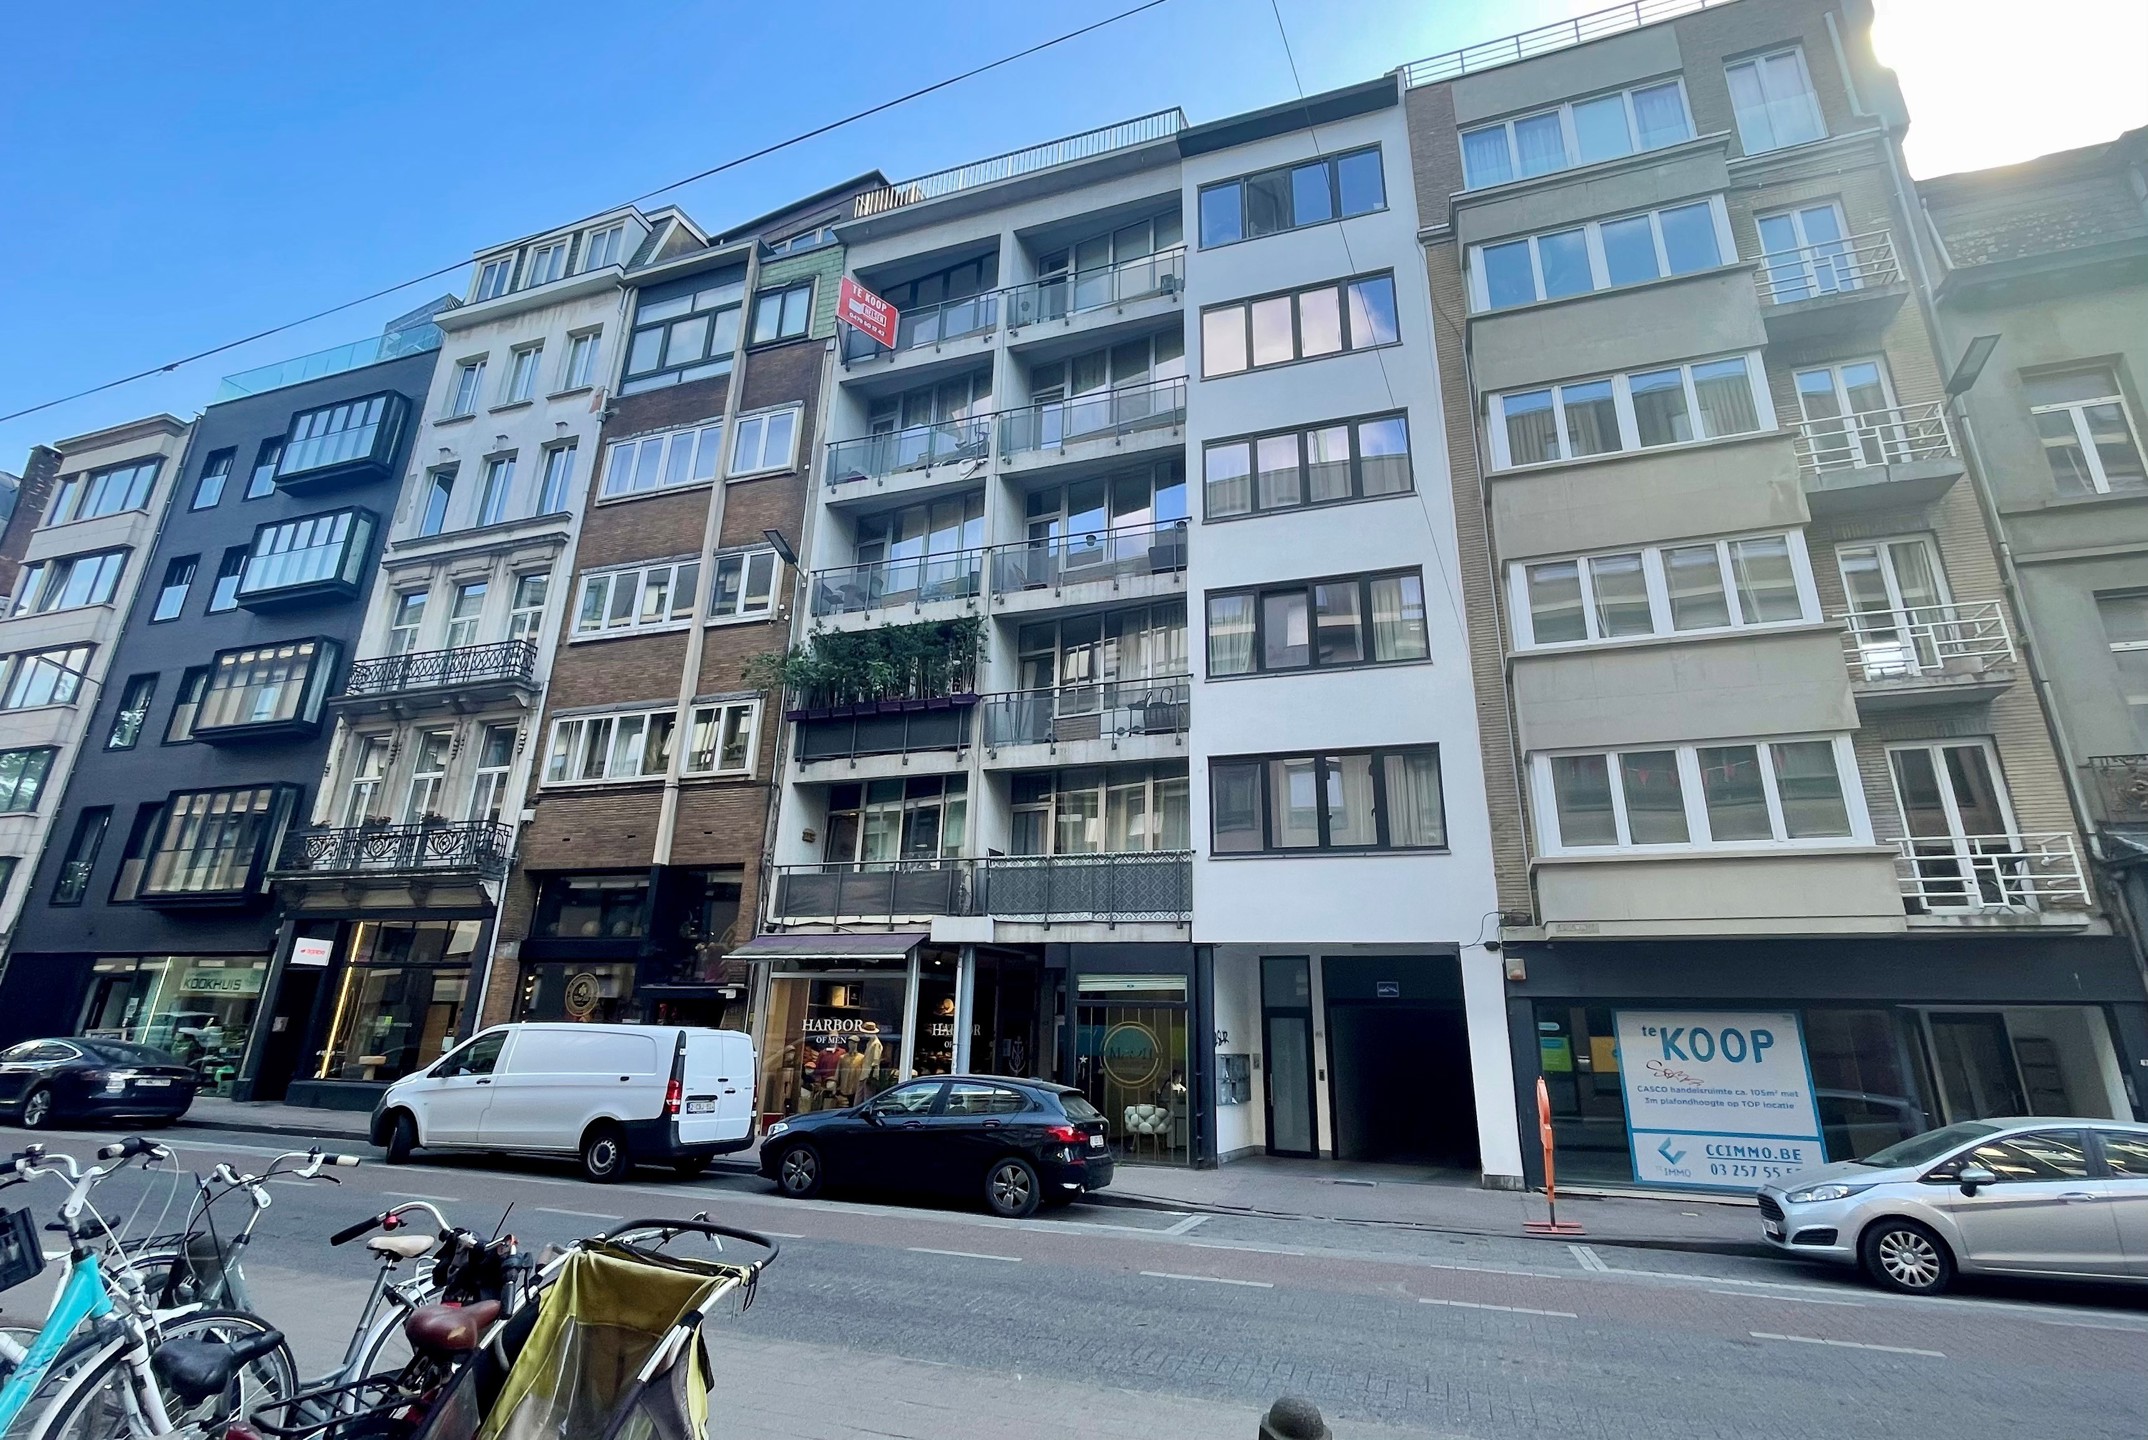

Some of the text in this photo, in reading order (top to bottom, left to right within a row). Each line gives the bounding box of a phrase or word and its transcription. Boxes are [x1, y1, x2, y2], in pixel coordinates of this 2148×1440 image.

[852, 285, 887, 312] TE KOOP
[183, 978, 242, 990] KOOKHUIS
[802, 1018, 864, 1032] HARBOR
[816, 1036, 847, 1044] OF MEN
[1642, 1025, 1774, 1063] te KOOP
[1637, 1085, 1668, 1093] CASCO
[1670, 1087, 1732, 1096] handelsruimte
[1781, 1090, 1799, 1098] met
[1660, 1098, 1724, 1107] plafondhoogte
[1742, 1100, 1760, 1108] TOP
[1706, 1144, 1802, 1160] CCIMMO.BE
[1664, 1167, 1692, 1178] IMMO
[1711, 1163, 1727, 1176] 03
[1733, 1164, 1757, 1178] 257
[1763, 1166, 1781, 1178] 55
